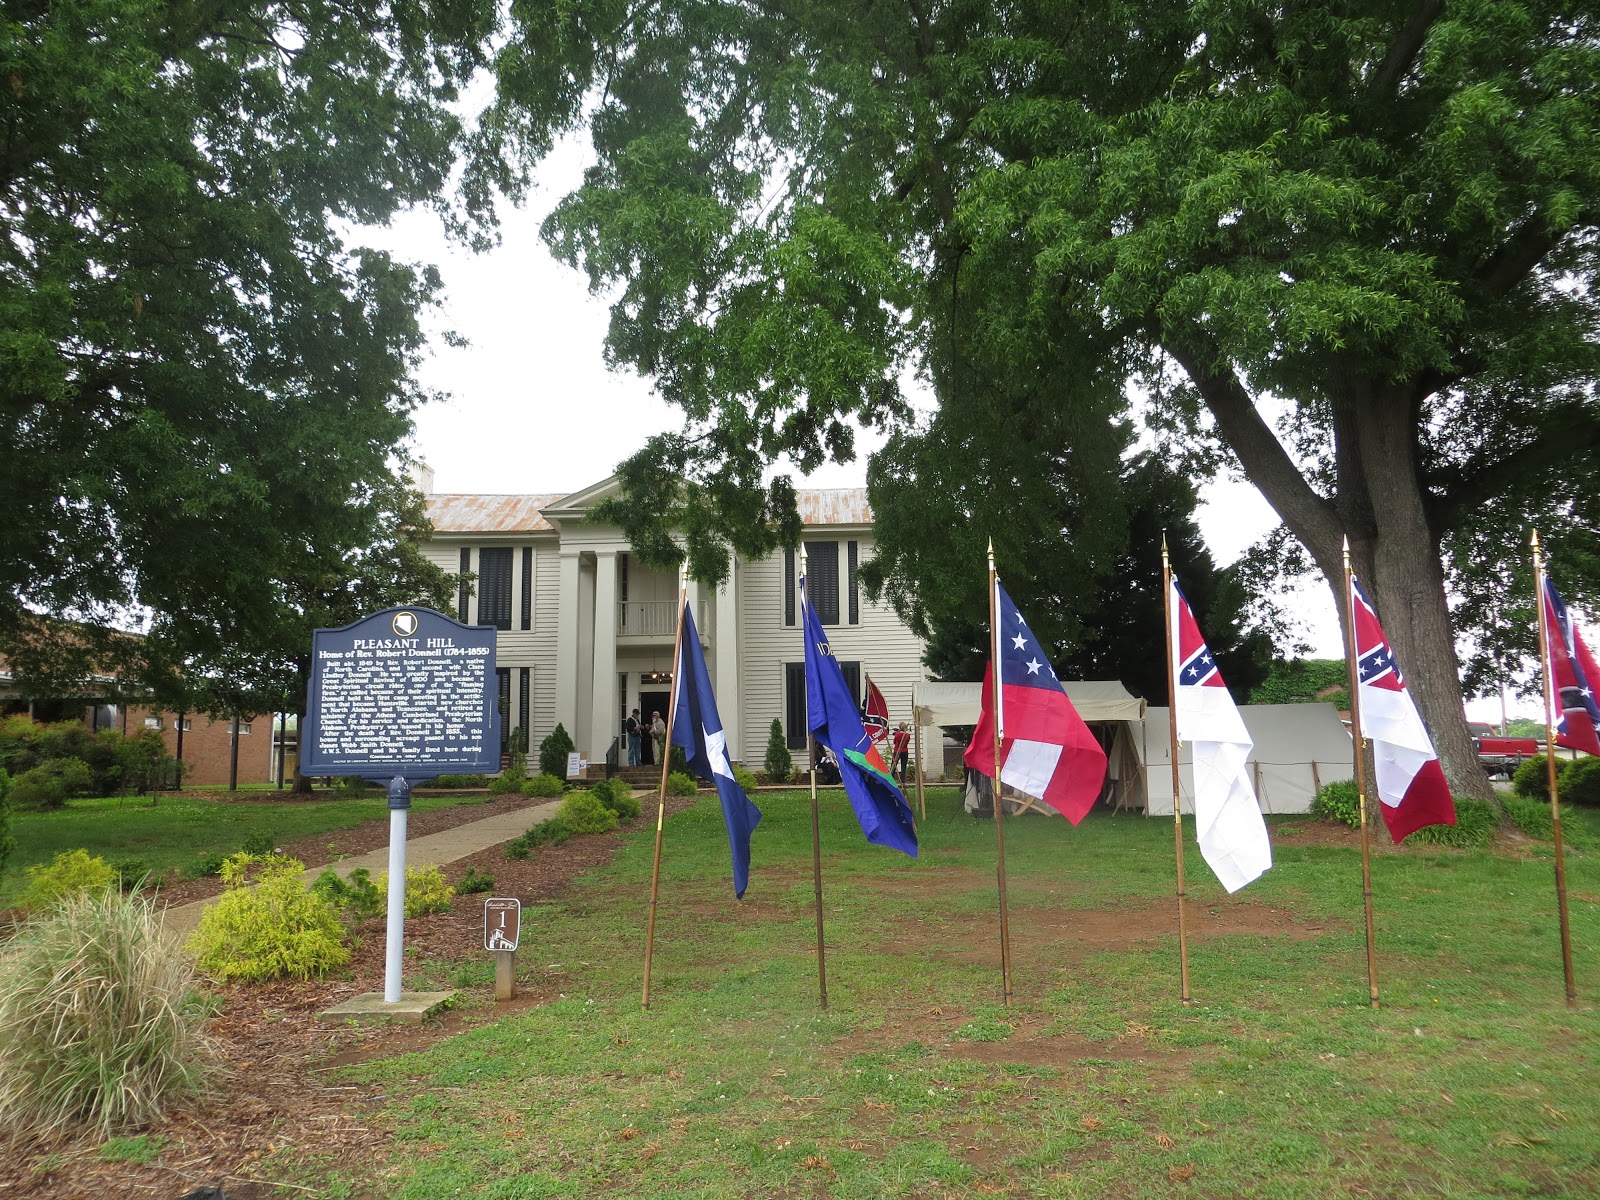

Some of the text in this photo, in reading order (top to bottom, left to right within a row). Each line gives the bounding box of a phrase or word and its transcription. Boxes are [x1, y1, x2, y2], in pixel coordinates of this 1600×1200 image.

[354, 638, 455, 649] PLEASANT HILL
[500, 910, 506, 928] 1
